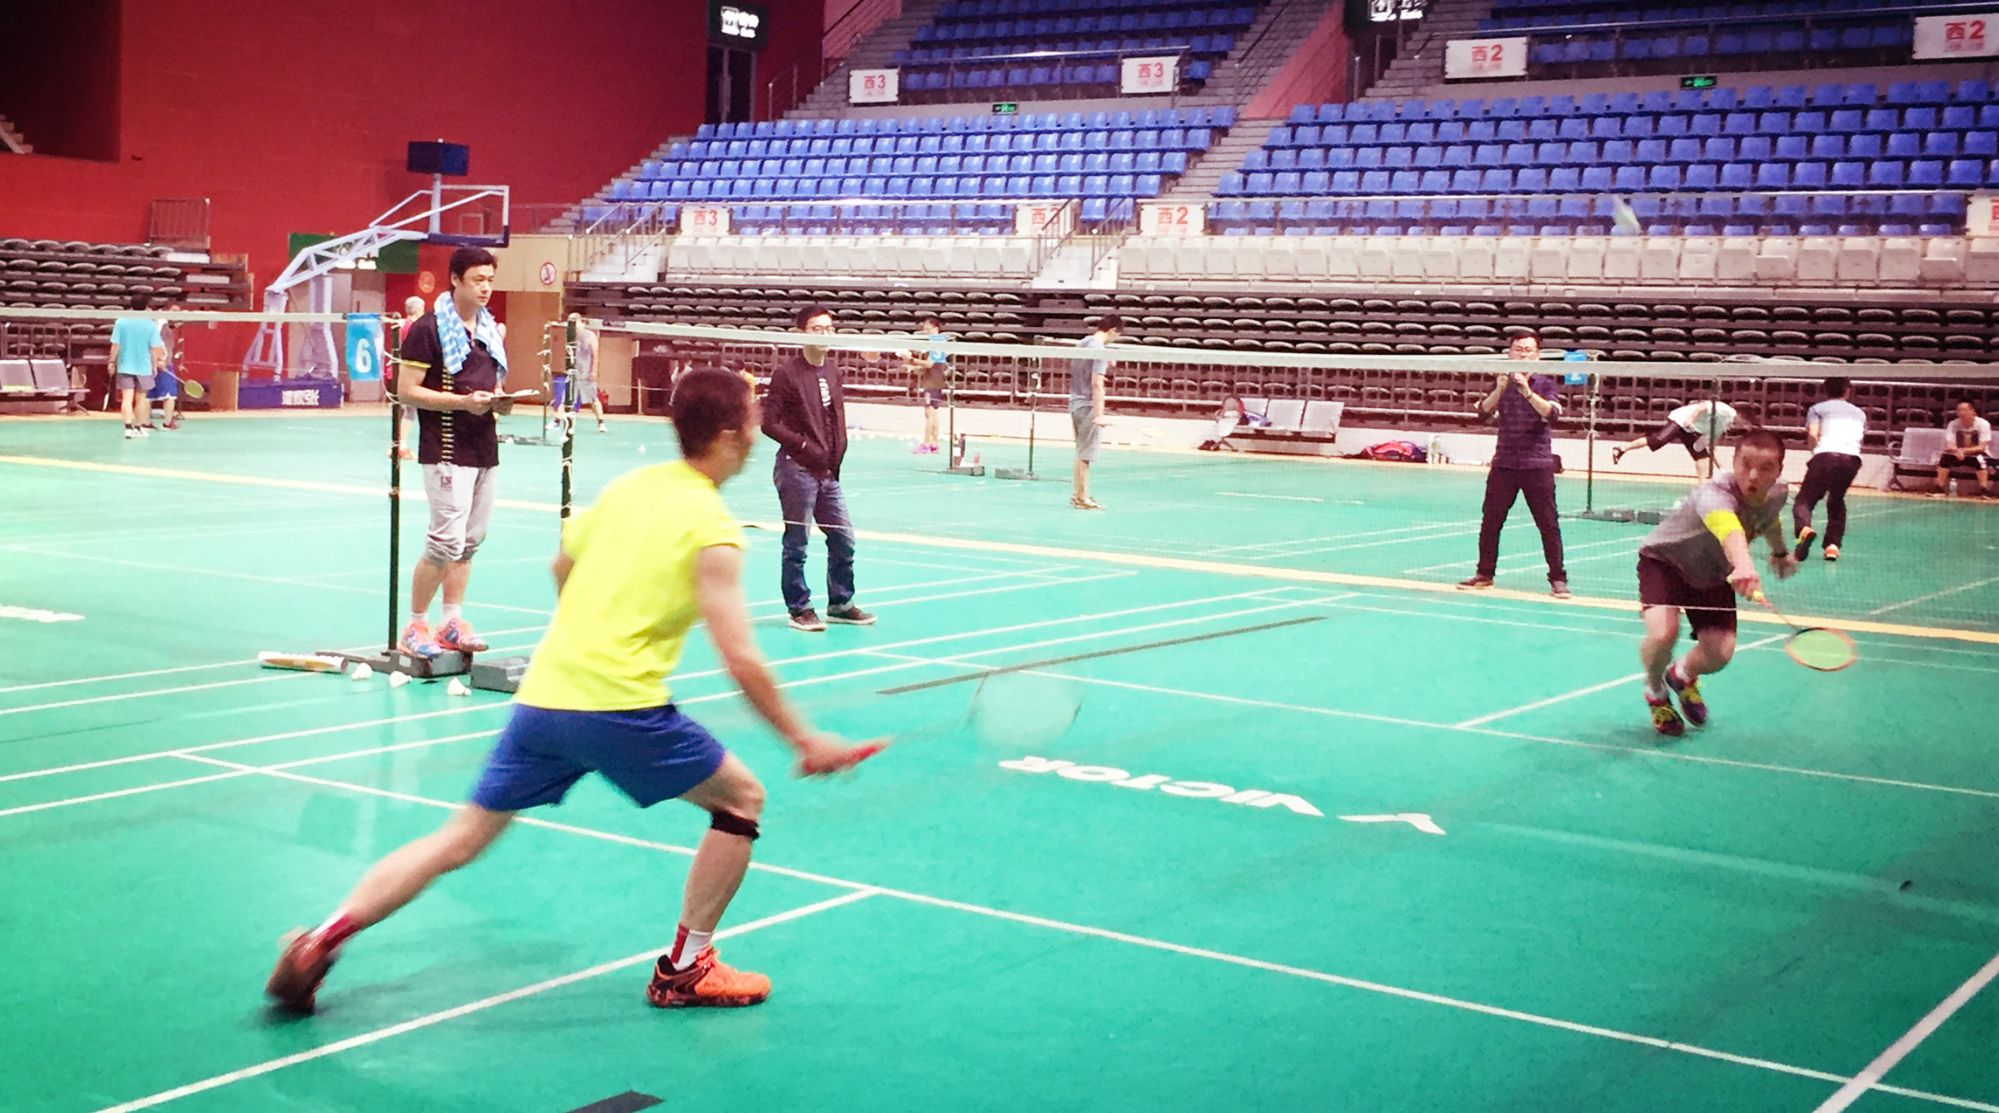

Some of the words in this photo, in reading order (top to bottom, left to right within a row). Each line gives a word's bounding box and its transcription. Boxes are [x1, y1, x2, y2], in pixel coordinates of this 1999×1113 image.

[1945, 20, 1985, 40] 西2
[1471, 44, 1503, 62] 西2
[1138, 62, 1164, 78] 西3
[693, 209, 717, 225] 西3
[1157, 206, 1188, 224] 西2
[356, 337, 372, 373] 6
[998, 756, 1325, 816] VICTOR
